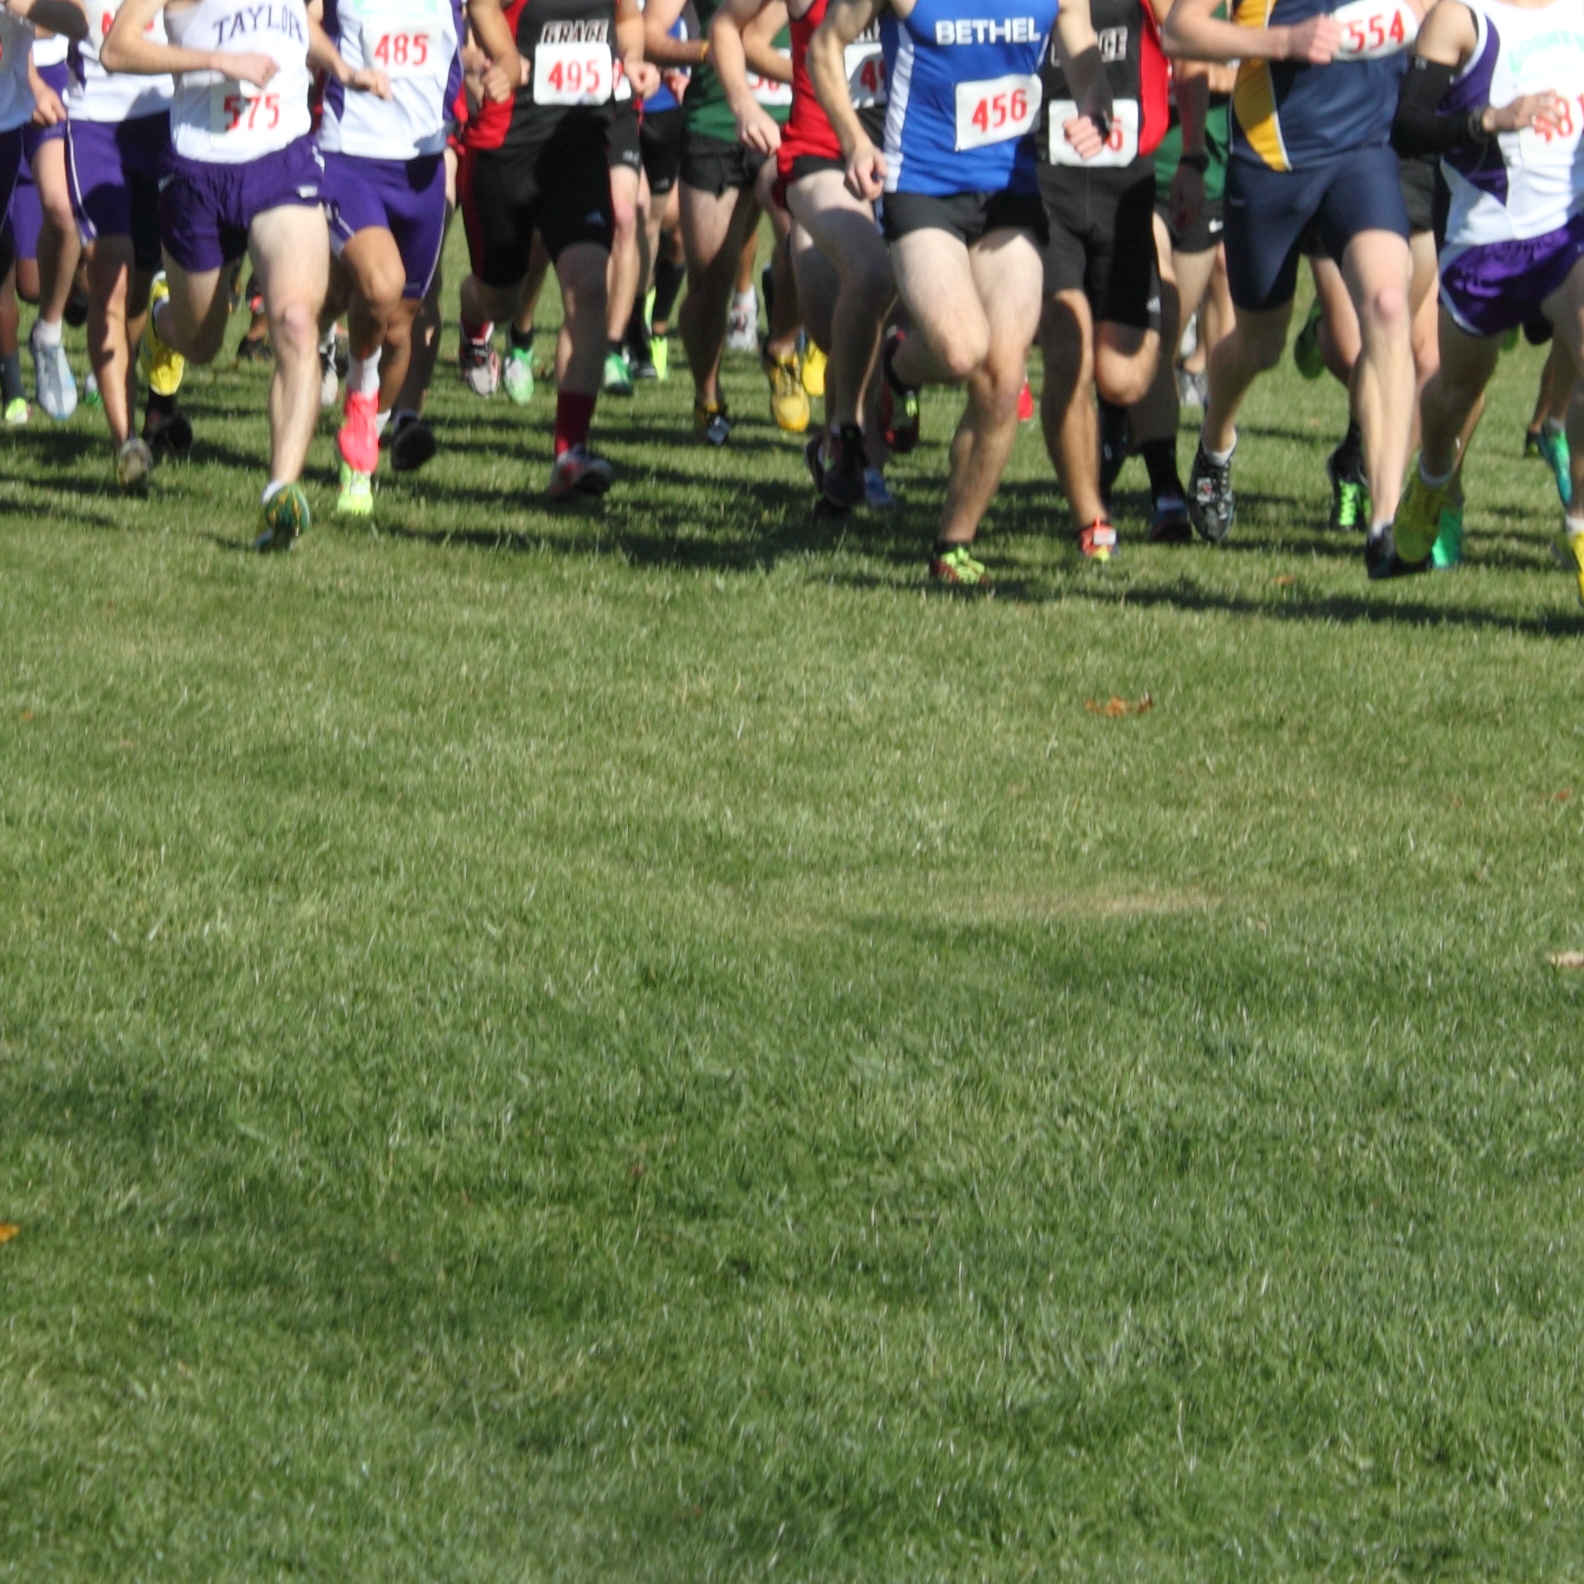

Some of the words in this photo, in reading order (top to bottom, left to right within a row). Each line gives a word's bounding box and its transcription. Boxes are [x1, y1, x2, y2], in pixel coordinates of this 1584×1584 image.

[374, 32, 430, 66] 485
[934, 17, 1041, 45] BETHEL
[1346, 9, 1405, 54] 554
[547, 60, 601, 94] 495
[223, 92, 280, 131] 575
[971, 87, 1029, 134] 456
